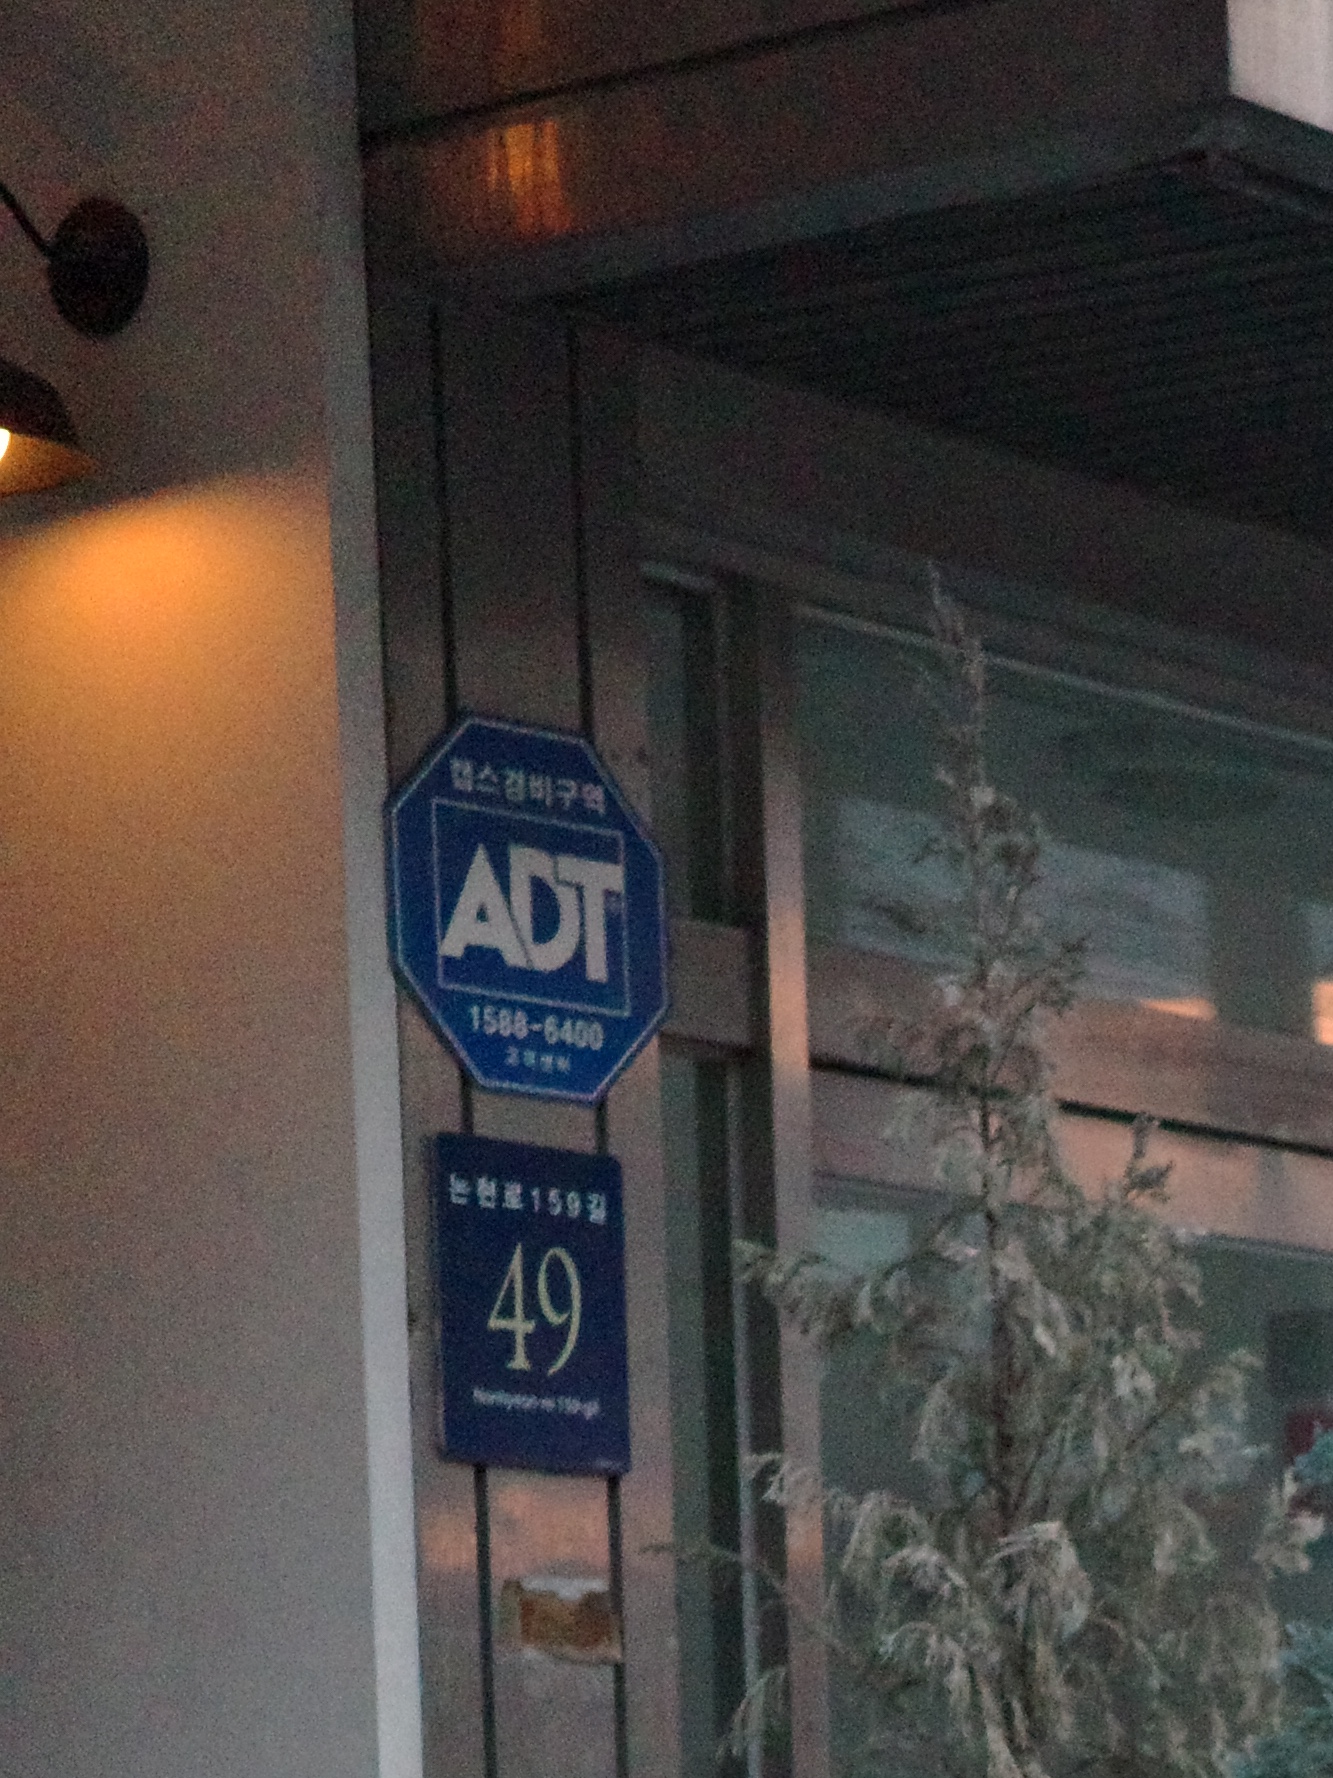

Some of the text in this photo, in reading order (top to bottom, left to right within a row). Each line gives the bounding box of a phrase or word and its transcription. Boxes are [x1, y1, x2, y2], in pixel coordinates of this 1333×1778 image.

[438, 843, 624, 983] ADT
[469, 1004, 604, 1050] 1588-6400
[487, 1243, 582, 1376] 49
